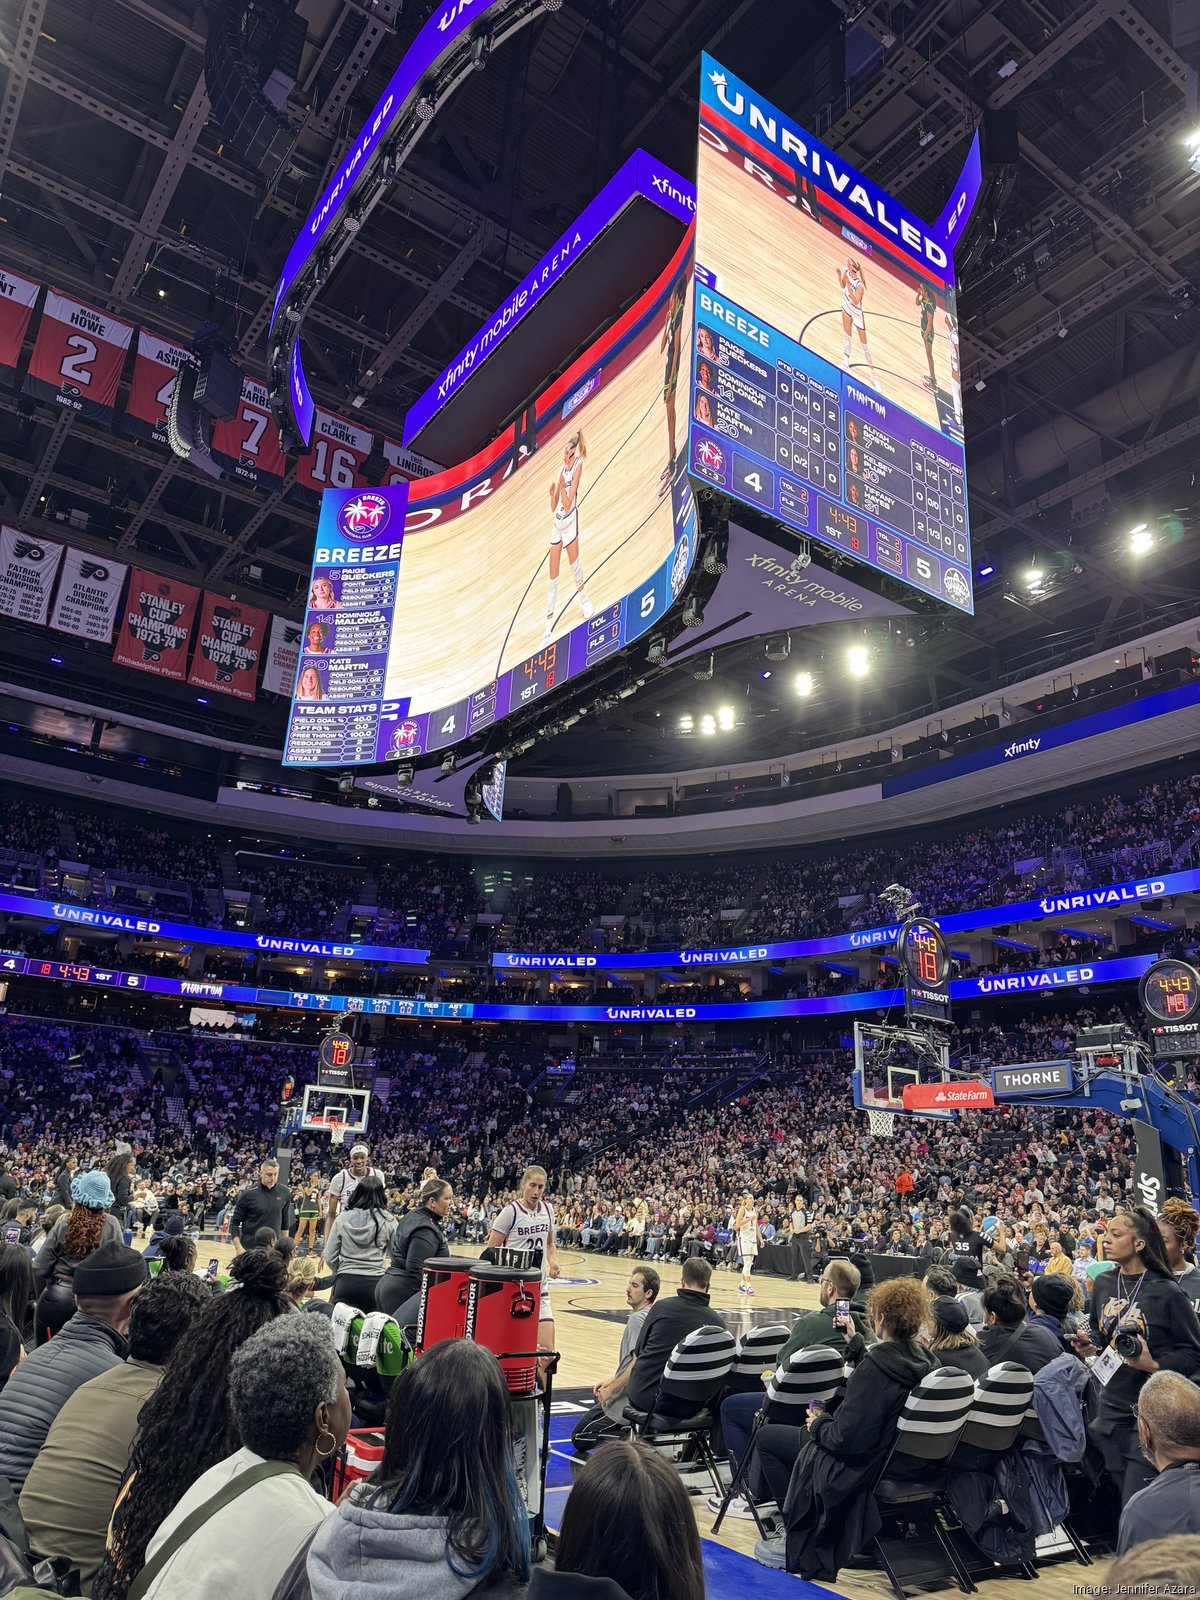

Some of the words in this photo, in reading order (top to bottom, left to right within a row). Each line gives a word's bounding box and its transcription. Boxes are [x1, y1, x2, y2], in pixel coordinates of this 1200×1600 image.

[311, 94, 394, 235] UNRIVALED
[716, 84, 948, 269] UNRIVALED
[70, 312, 106, 337] HOWE
[79, 308, 101, 323] MARK
[437, 343, 479, 401] xfinity
[480, 290, 528, 352] mobile
[531, 232, 582, 295] ARENA
[700, 293, 770, 349] BREEZE
[719, 336, 745, 358] PAIGE
[59, 333, 98, 387] 2
[718, 343, 768, 378] BUECKERS
[253, 386, 267, 397] BILL
[718, 368, 767, 402] DOMINIQUE
[718, 376, 764, 408] MALONGA
[825, 388, 839, 400] AST
[55, 394, 83, 411] 1982-92
[717, 402, 741, 420] KATE
[780, 383, 789, 393] 0
[794, 391, 808, 405] 0/1
[812, 401, 821, 412] 0
[828, 410, 836, 421] 2
[846, 385, 886, 419] PHANTOM
[242, 408, 269, 455] 7
[331, 419, 350, 432] BOBBY
[716, 418, 739, 438] 20
[717, 410, 753, 435] MARTIN
[321, 422, 357, 446] CLARKE
[780, 415, 789, 425] 4
[794, 422, 808, 435] 2/2
[812, 433, 821, 443] 3
[828, 441, 837, 452] 0
[863, 424, 890, 443] ALIYAH
[863, 430, 895, 453] BOSTON
[310, 439, 357, 488] 16
[410, 455, 423, 466] ERIC
[780, 447, 789, 458] 0
[794, 454, 808, 468] 0/2
[828, 473, 837, 484] 0
[863, 453, 893, 474] KELSEY
[863, 460, 886, 478] PLUM
[235, 466, 258, 481] 1972-84
[744, 472, 763, 493] 4
[915, 462, 922, 472] 3
[926, 468, 938, 481] 1/2
[954, 485, 962, 494] 0
[362, 495, 386, 506] BREEZE
[781, 481, 795, 493] TOL
[800, 490, 807, 501] 2
[864, 484, 896, 506] TIFFANY
[864, 491, 890, 510] HAYES
[781, 496, 795, 507] FLS
[915, 491, 924, 501] 0
[927, 498, 939, 510] 0/0
[956, 515, 964, 523] 0
[829, 506, 857, 533] 4:43
[825, 525, 843, 539] 1ST
[851, 537, 860, 550] 18
[878, 531, 890, 542] TOL
[916, 521, 925, 532] 2
[928, 528, 941, 540] 1/3
[944, 536, 952, 546] 0
[957, 543, 965, 553] 0
[315, 543, 402, 563] BREEZE
[878, 546, 890, 556] FLS
[6, 569, 40, 586] DIVISION
[8, 562, 42, 578] PATRICK
[329, 570, 341, 580] 5
[341, 570, 395, 580] BUECKERS
[916, 557, 931, 579] 5
[72, 583, 109, 599] ATLANTIC
[72, 590, 105, 605] DIVISION
[762, 579, 817, 607] ARENA
[803, 582, 864, 612] mobile
[65, 595, 109, 613] CHAMPIONS
[139, 591, 186, 615] STANLEY
[640, 588, 656, 619] 5
[149, 607, 171, 623] CUP
[335, 611, 381, 619] DOMINIQUE
[335, 615, 387, 625] MALONGA
[591, 616, 606, 630] TOL
[612, 605, 619, 618] 2
[128, 612, 188, 640] CHAMPIONS
[212, 615, 256, 638] STANLEY
[135, 627, 177, 649] 1973-74
[221, 630, 242, 644] CUP
[589, 634, 605, 650] FLS
[612, 624, 618, 637] 0
[201, 634, 258, 662] CHAMPIONS
[117, 654, 161, 674] Philadelphia
[161, 667, 182, 678] Flyers
[208, 649, 247, 670] 1974-75
[328, 663, 369, 671] MARTIN
[523, 643, 557, 681] 4:43
[191, 675, 232, 694] Philadelphia
[232, 687, 252, 698] Flyers
[475, 691, 487, 701] TOL
[520, 683, 538, 701] 1ST
[298, 706, 336, 715] TEAM
[338, 703, 378, 714] STATS
[473, 707, 484, 719] FLS
[441, 714, 456, 734] 4
[1004, 738, 1041, 757] xfinity
[1041, 881, 1165, 913] UNRIVALED
[53, 905, 161, 933] UNRIVALED
[256, 937, 354, 956] UNRIVALED
[680, 948, 768, 963] UNRIVALED
[3, 959, 16, 970] 4
[508, 954, 597, 967] UNRIVALED
[918, 951, 937, 981] 18
[40, 963, 51, 975] 18
[58, 965, 90, 981] 4:43
[95, 973, 113, 981] 1ST
[127, 976, 139, 987] 5
[979, 968, 1094, 993] UNRIVALED
[180, 982, 223, 998] PHANTOM
[1159, 976, 1190, 993] 4:43
[315, 994, 330, 1002] TOL
[922, 990, 949, 1003] TISSOT
[1165, 993, 1188, 1013] 18
[607, 1007, 697, 1019] UNRIVALED
[1163, 1023, 1199, 1033] TISSOT
[332, 1049, 346, 1065] 18
[1003, 1070, 1061, 1086] THORNE
[517, 1224, 549, 1236] BREEZE
[955, 1242, 970, 1252] 35
[416, 1273, 428, 1343] BODYARMOR
[465, 1283, 477, 1340] DYARMOR
